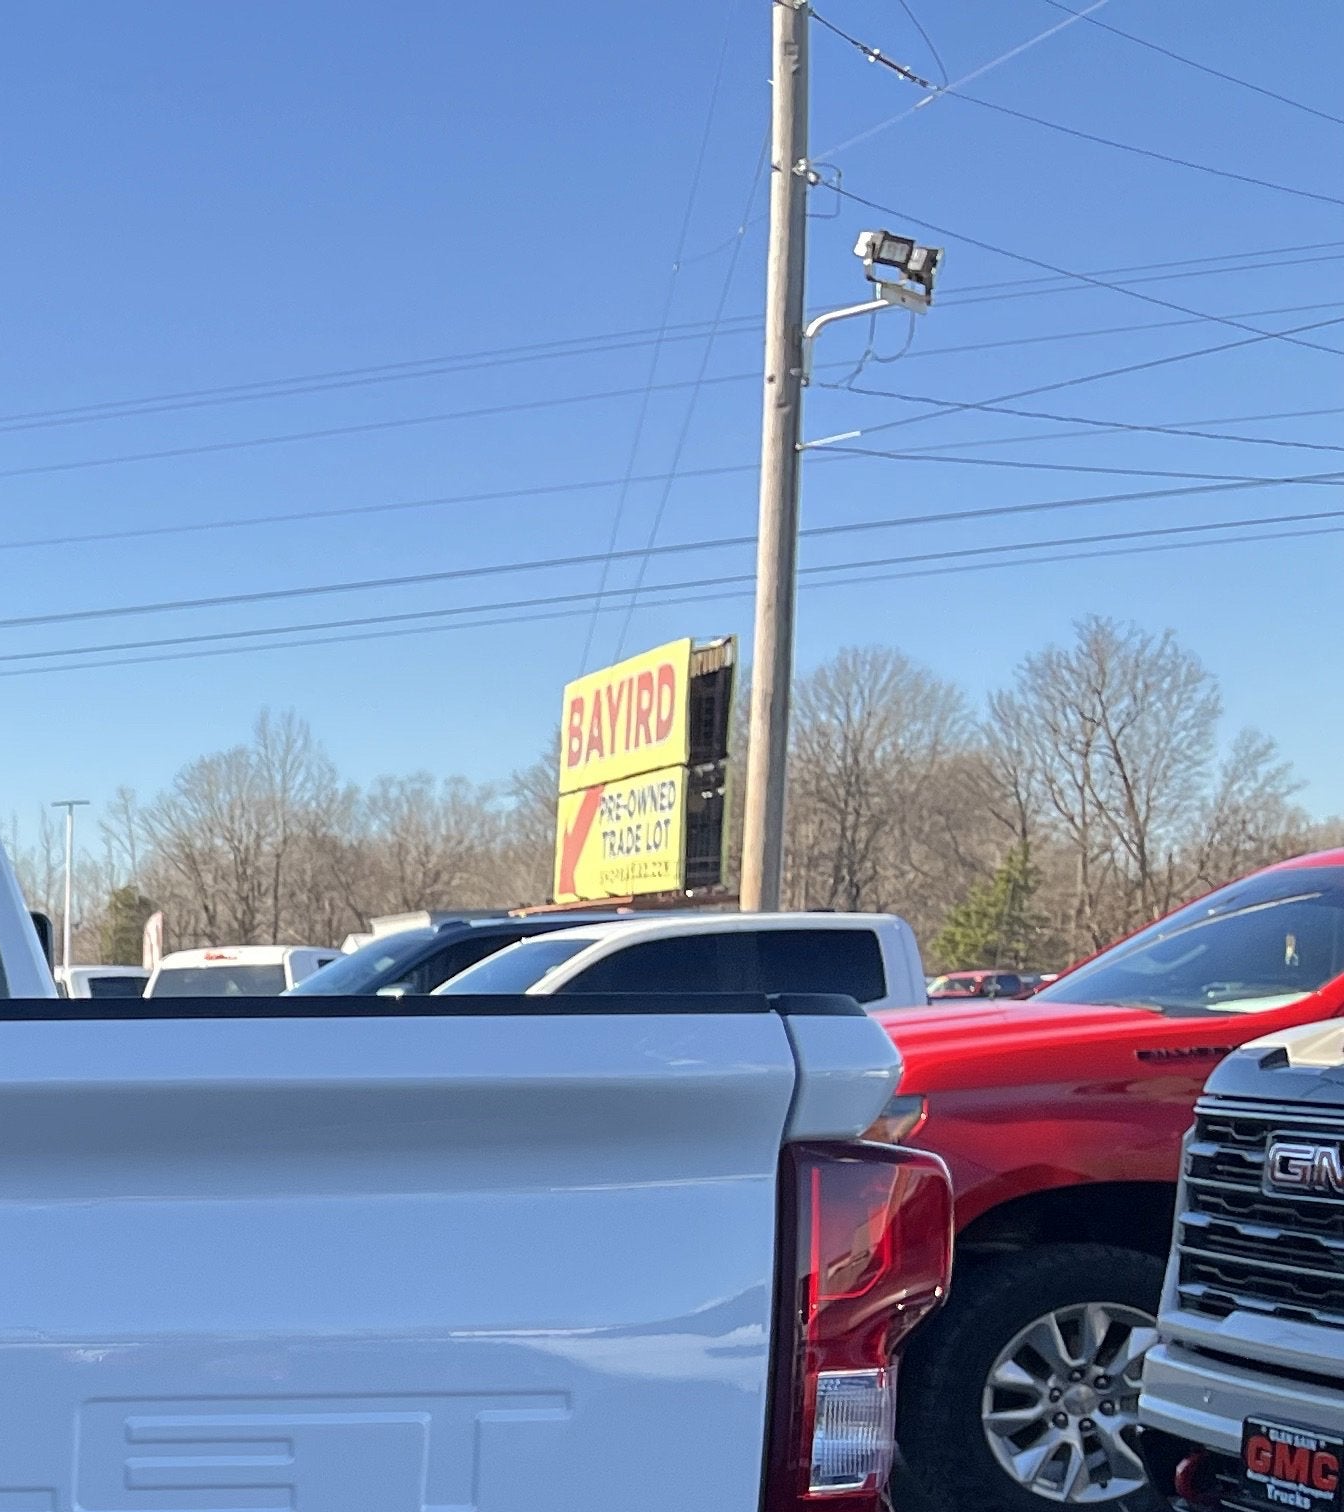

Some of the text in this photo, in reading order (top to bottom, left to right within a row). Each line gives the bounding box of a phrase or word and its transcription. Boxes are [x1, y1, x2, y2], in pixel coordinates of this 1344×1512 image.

[567, 663, 676, 768] BAYIRD
[599, 780, 676, 825] PRE-OWNED
[602, 818, 671, 860] TRADE LOT
[1247, 1434, 1339, 1494] GMC
